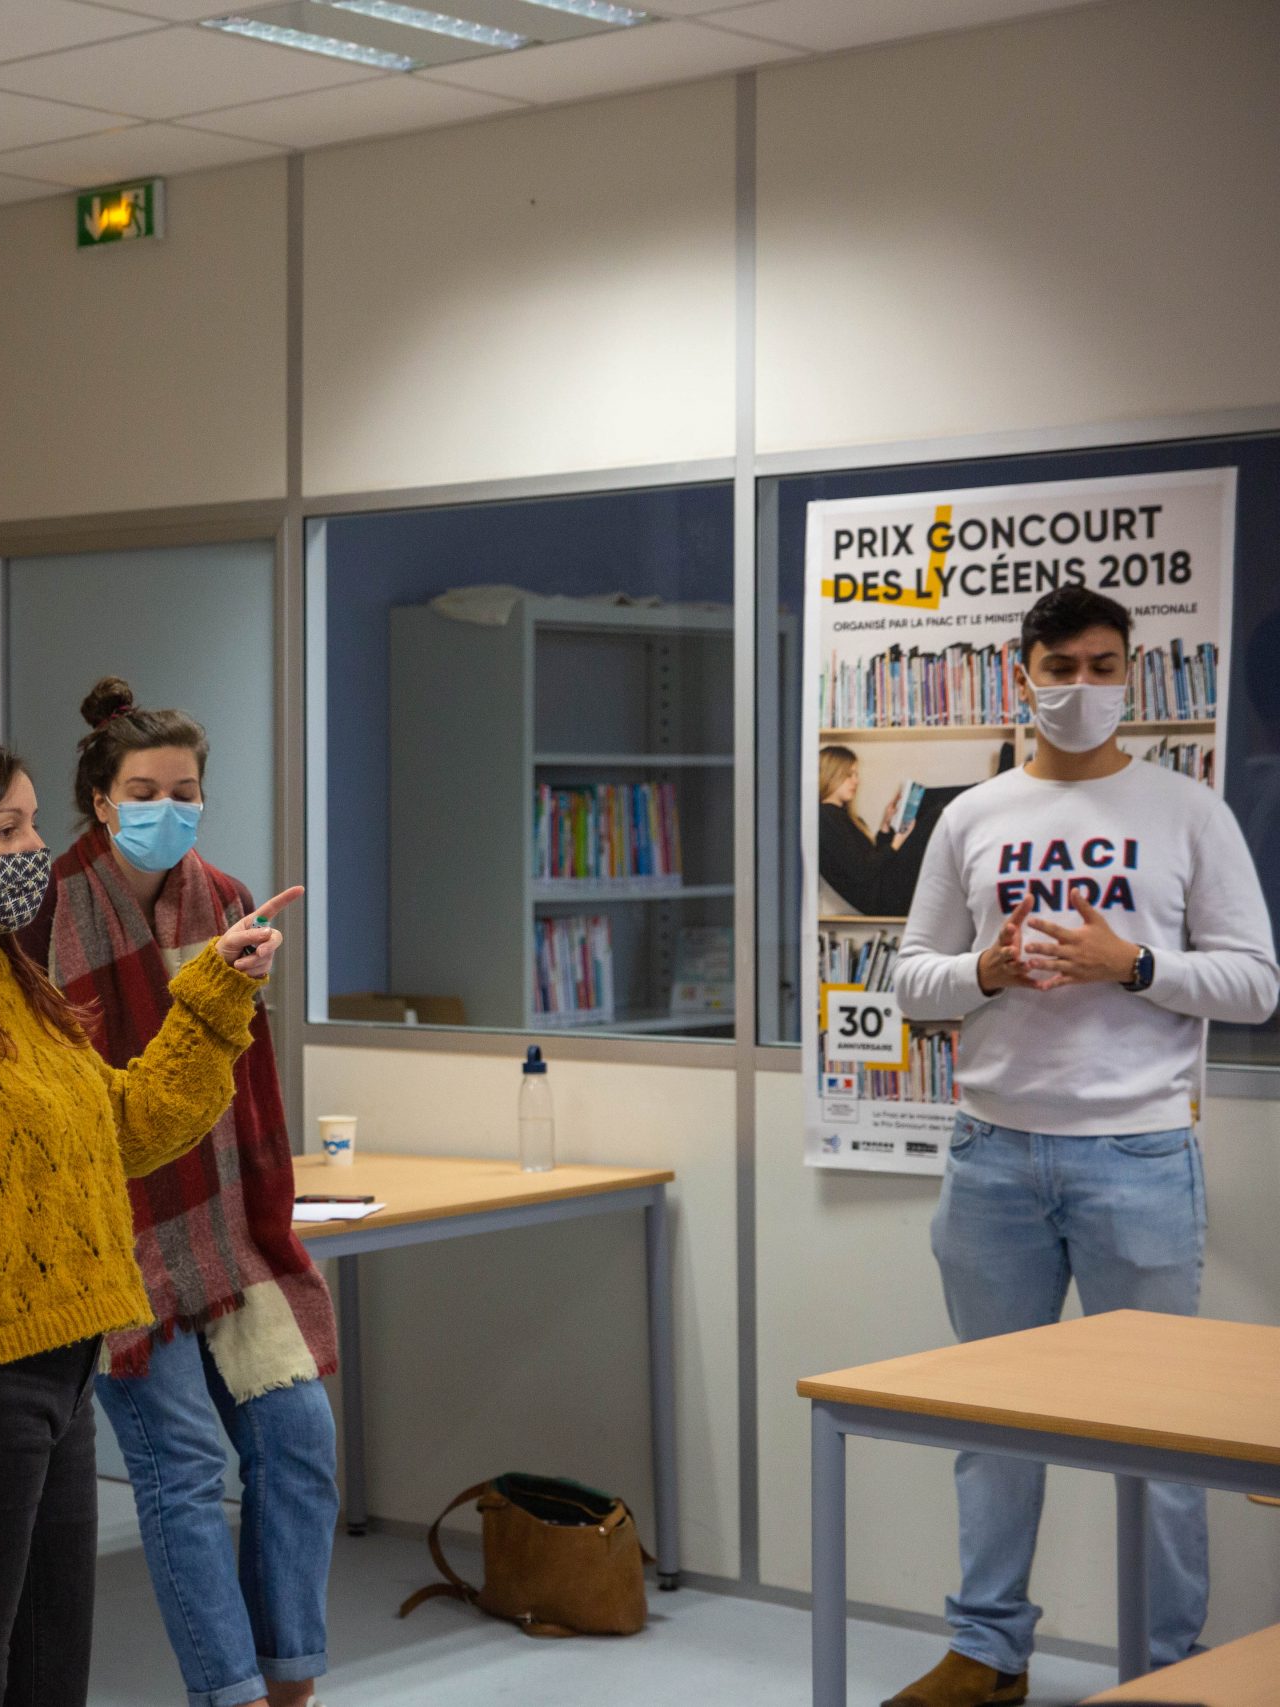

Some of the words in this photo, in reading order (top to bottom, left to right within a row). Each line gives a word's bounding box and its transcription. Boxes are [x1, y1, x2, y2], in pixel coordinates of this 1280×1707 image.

[834, 523, 914, 560] PRIX
[927, 505, 1162, 553] GONCOURT
[833, 569, 903, 603] DES
[916, 553, 1086, 599] LYCÉENS
[1098, 550, 1192, 589] 2018
[833, 618, 886, 632] ORGANISÉ
[888, 617, 908, 629] PAR
[910, 617, 924, 628] LA
[926, 615, 954, 627] FNAC
[956, 614, 968, 626] ET
[970, 614, 983, 625] LE
[1134, 602, 1198, 616] NATIONALE
[998, 836, 1138, 875] HACI
[996, 875, 1136, 914] ENDA
[837, 1042, 893, 1052] ANNIVERSAIRE
